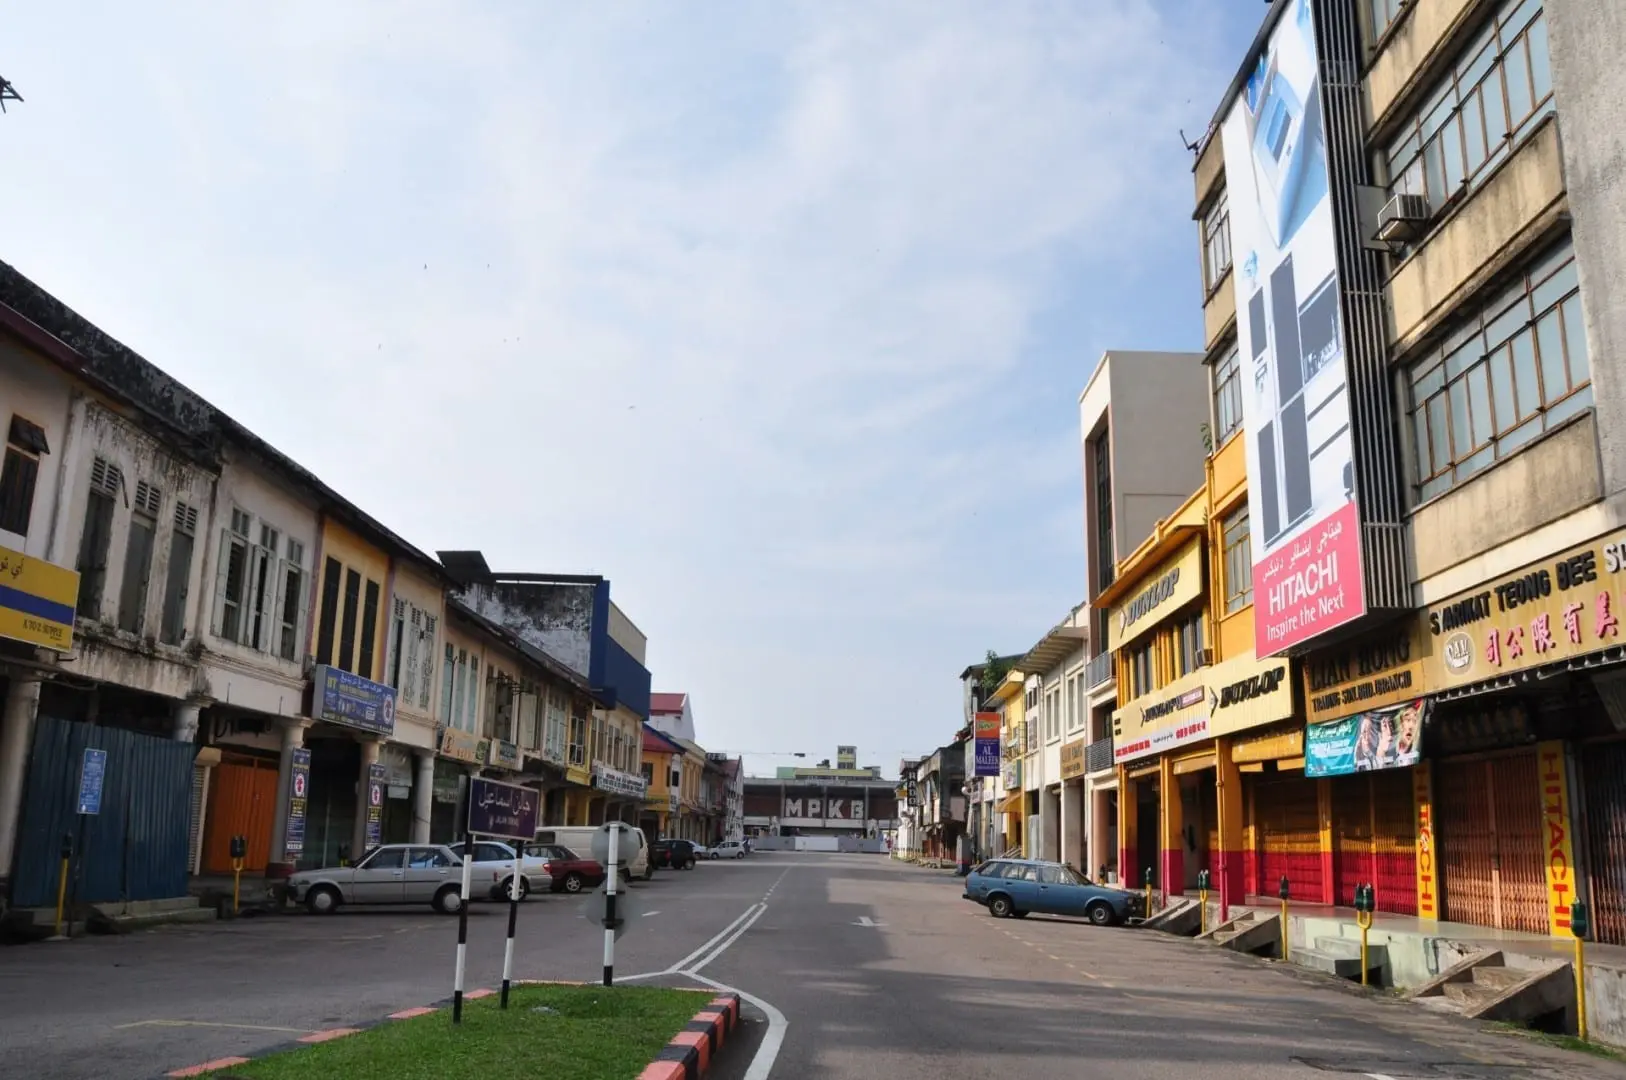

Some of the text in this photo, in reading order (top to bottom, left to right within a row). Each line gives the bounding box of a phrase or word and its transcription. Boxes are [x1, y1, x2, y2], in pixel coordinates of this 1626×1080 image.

[1127, 567, 1180, 628] DUNLOP
[1268, 550, 1339, 616] HITACHI
[1494, 569, 1551, 613] TEONG
[1556, 550, 1598, 591] BEE
[1266, 584, 1345, 643] Inspire the Next
[1219, 666, 1286, 709] DUNLOP
[786, 798, 864, 819] MPKB
[1543, 752, 1571, 928] HITACHI
